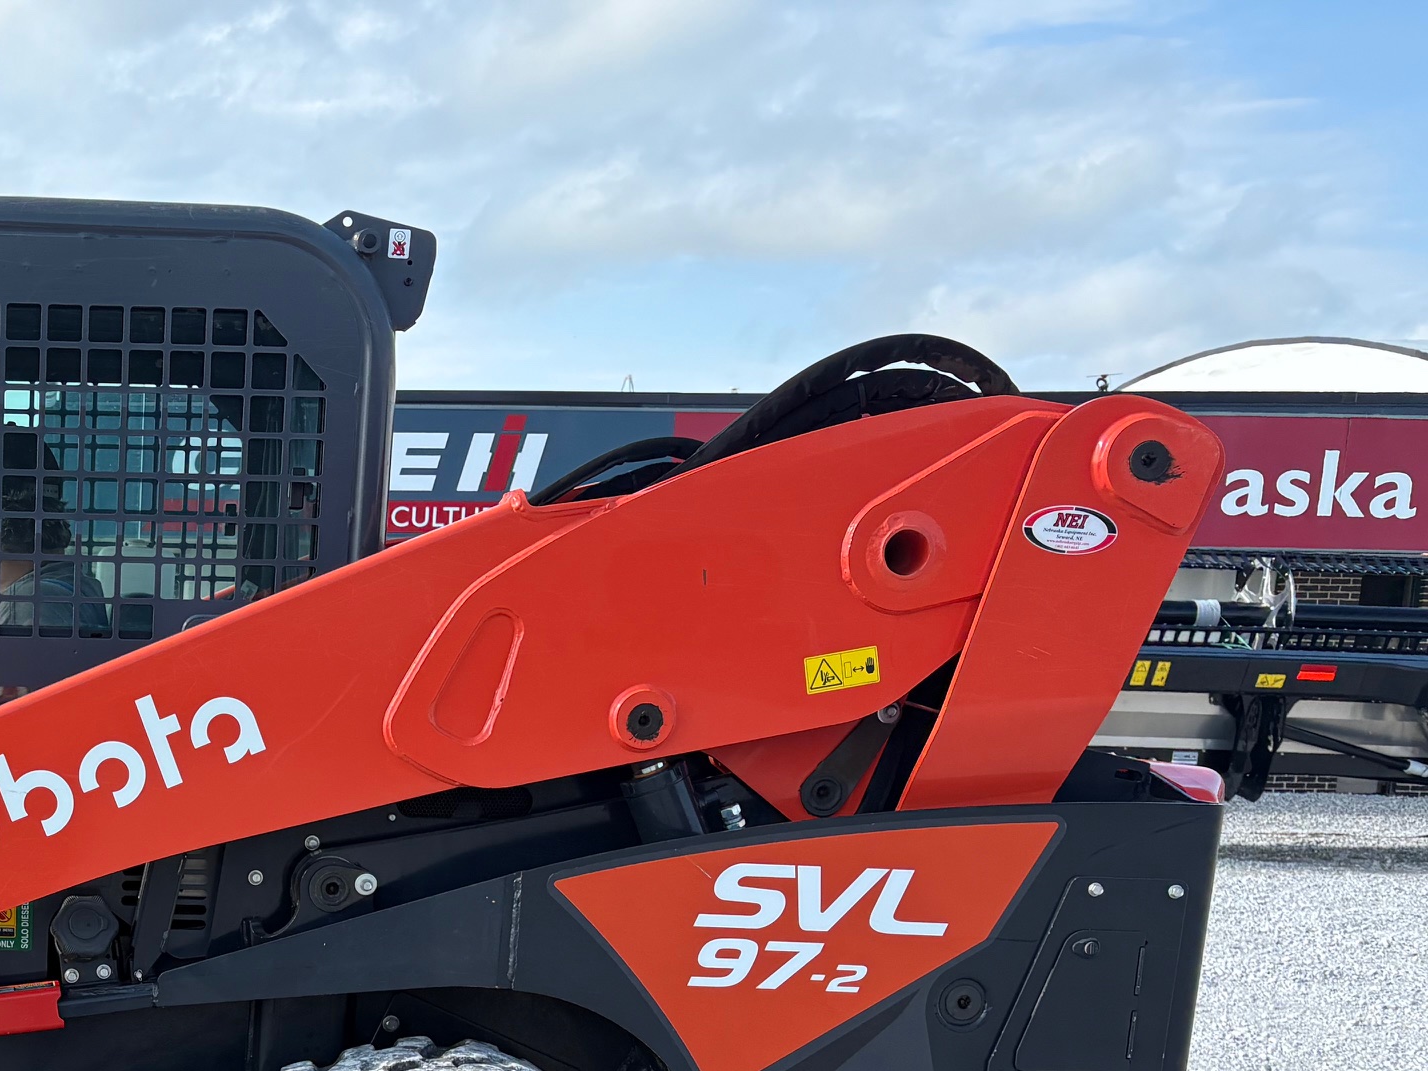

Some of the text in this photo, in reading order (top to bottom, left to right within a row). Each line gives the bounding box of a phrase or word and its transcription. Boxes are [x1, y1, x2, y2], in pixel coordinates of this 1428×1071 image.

[1053, 512, 1090, 530] NEI
[693, 863, 949, 937] SVL
[20, 928, 29, 949] SOLO
[687, 938, 868, 993] 97-2
